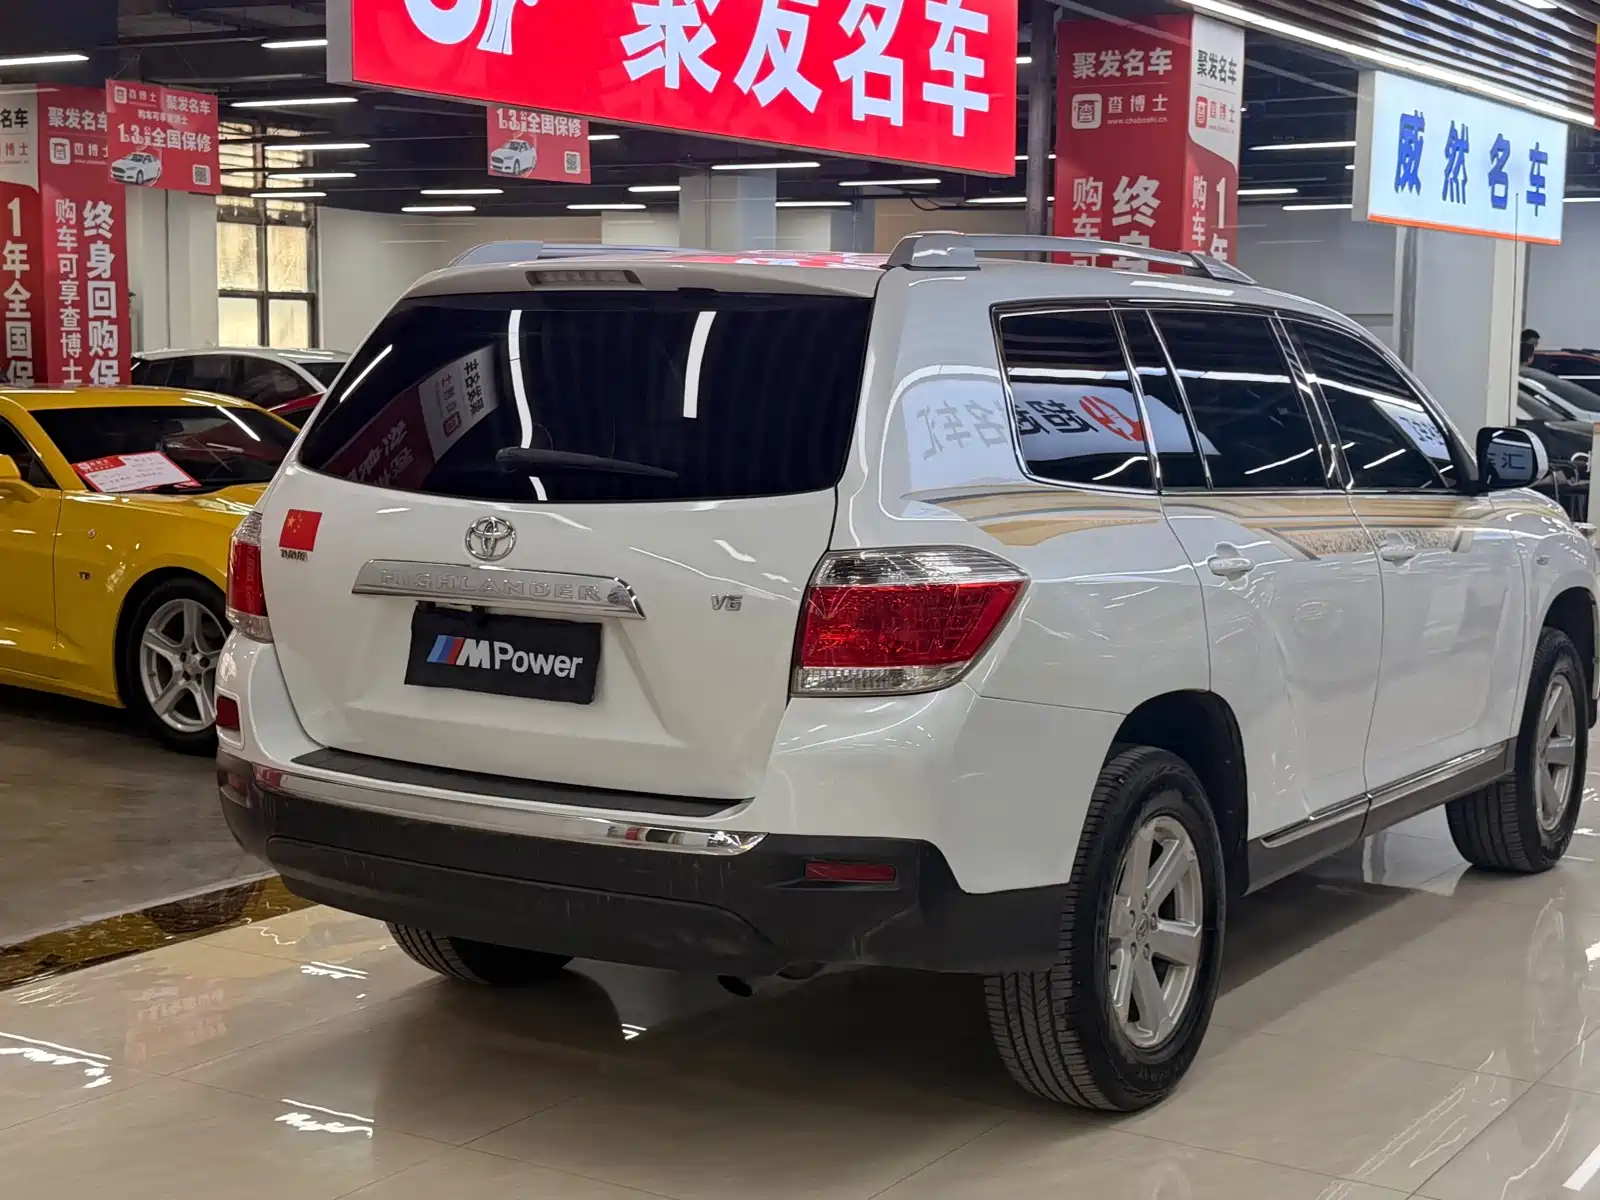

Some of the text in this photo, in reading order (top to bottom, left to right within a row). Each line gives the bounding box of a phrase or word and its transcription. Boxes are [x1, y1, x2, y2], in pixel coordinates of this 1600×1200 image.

[1073, 48, 1173, 79] 聚发名车
[1197, 50, 1237, 85] 聚发名车
[0, 108, 29, 128] 名车
[165, 95, 211, 114] 聚发名车
[55, 199, 83, 385] 购车可享查博士
[83, 200, 120, 387] 终身回购保
[381, 570, 602, 601] HIGHLANDER
[711, 594, 743, 612] V6
